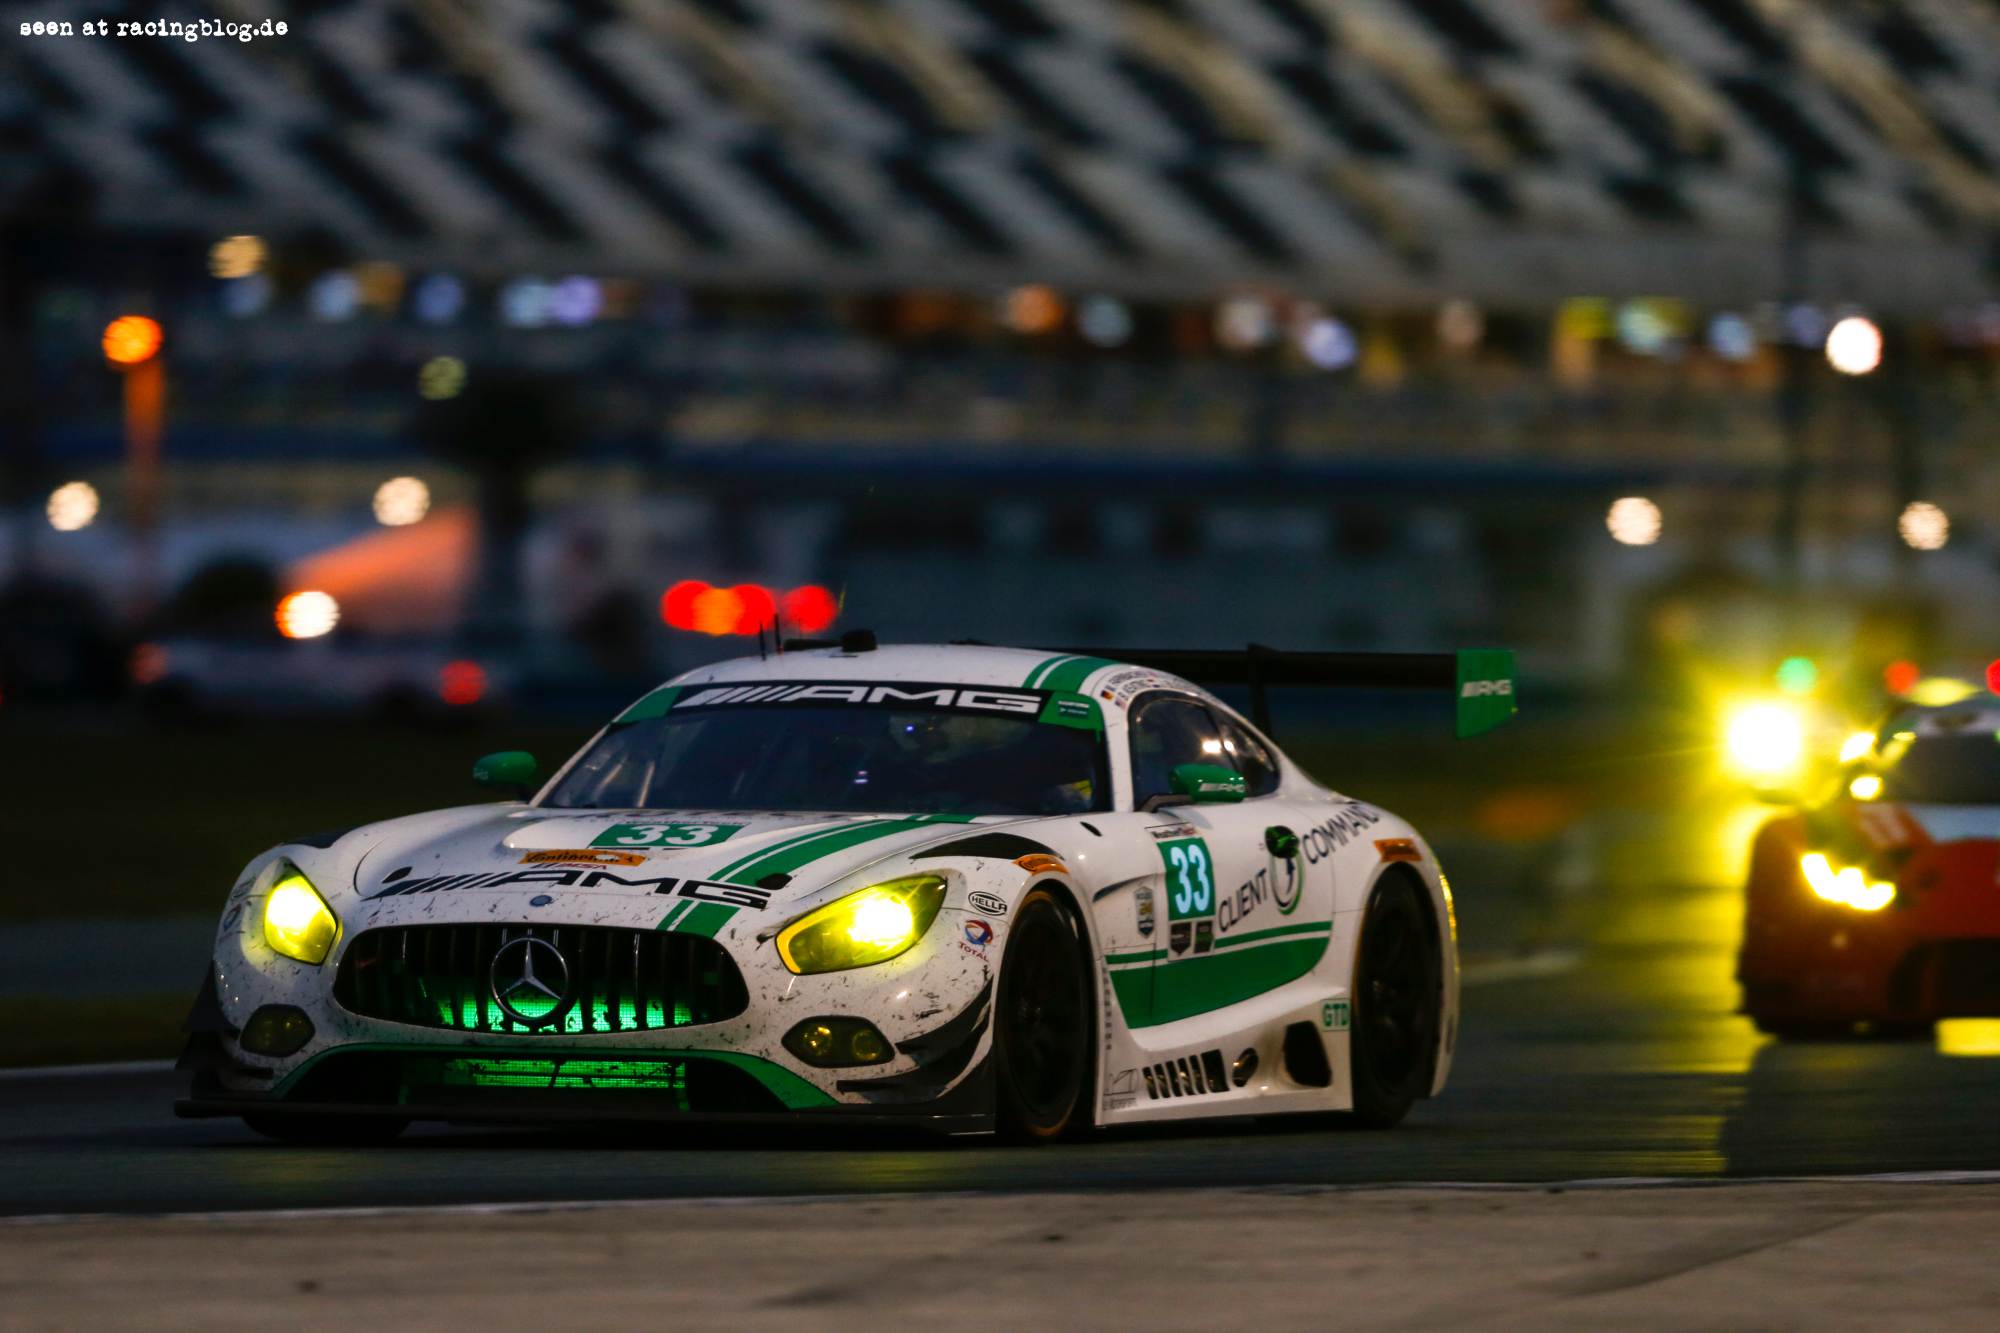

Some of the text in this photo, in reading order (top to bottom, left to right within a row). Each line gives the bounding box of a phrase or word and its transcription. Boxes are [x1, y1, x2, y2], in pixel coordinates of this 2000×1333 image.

[778, 685, 1041, 714] AMG
[616, 824, 719, 845] 33
[1170, 844, 1210, 914] 33
[1218, 804, 1380, 932] CLIENT COMMAND
[481, 869, 771, 910] AMG
[971, 894, 1008, 912] HELLA
[959, 942, 989, 961] TOTAL
[1322, 1003, 1350, 1027] GTD
